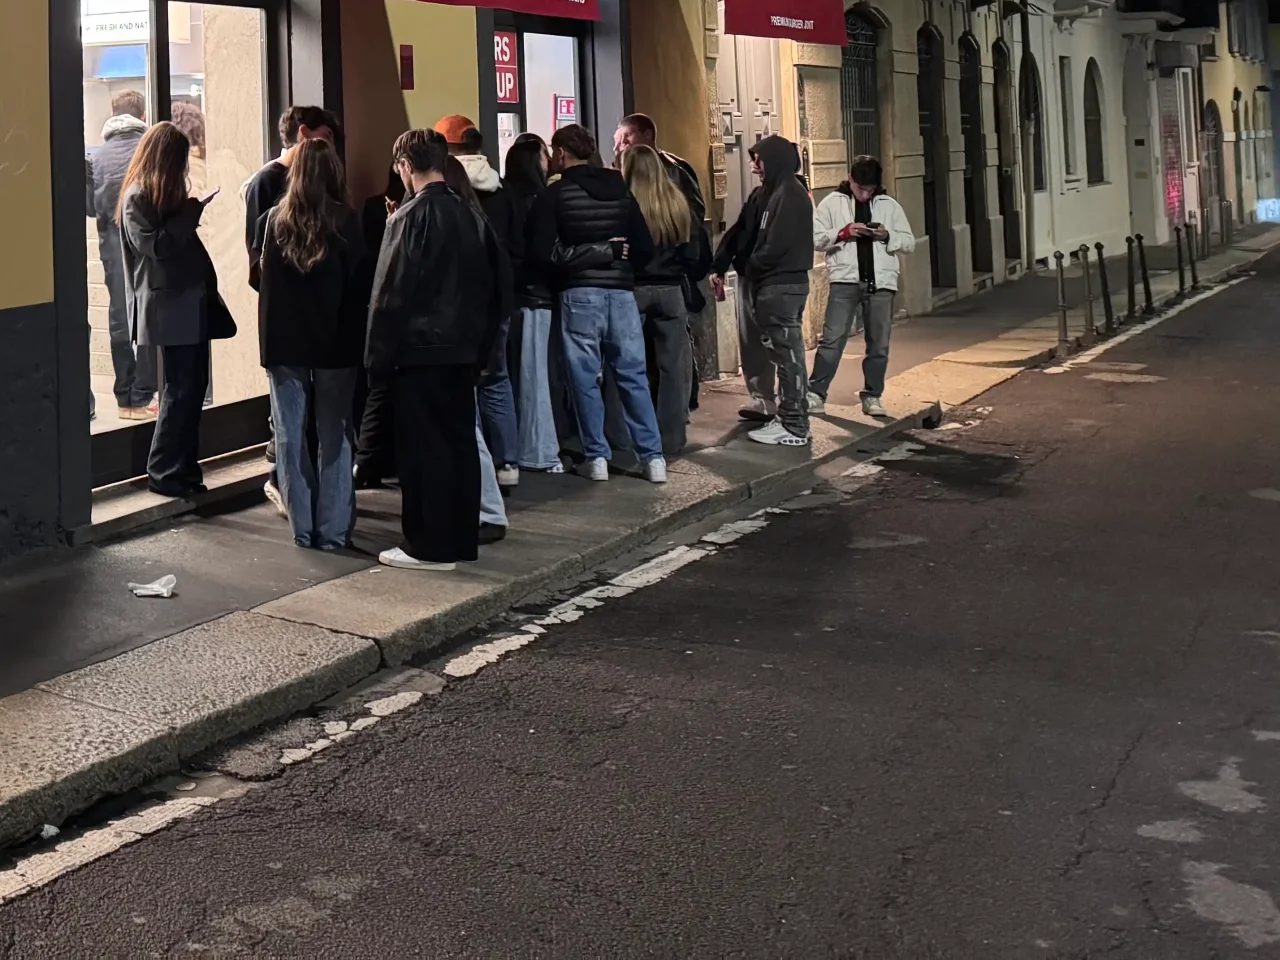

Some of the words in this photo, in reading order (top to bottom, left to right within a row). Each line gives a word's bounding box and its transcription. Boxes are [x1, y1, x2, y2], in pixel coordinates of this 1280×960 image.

[119, 22, 134, 30] AND
[494, 35, 511, 62] RS
[496, 71, 514, 98] UP
